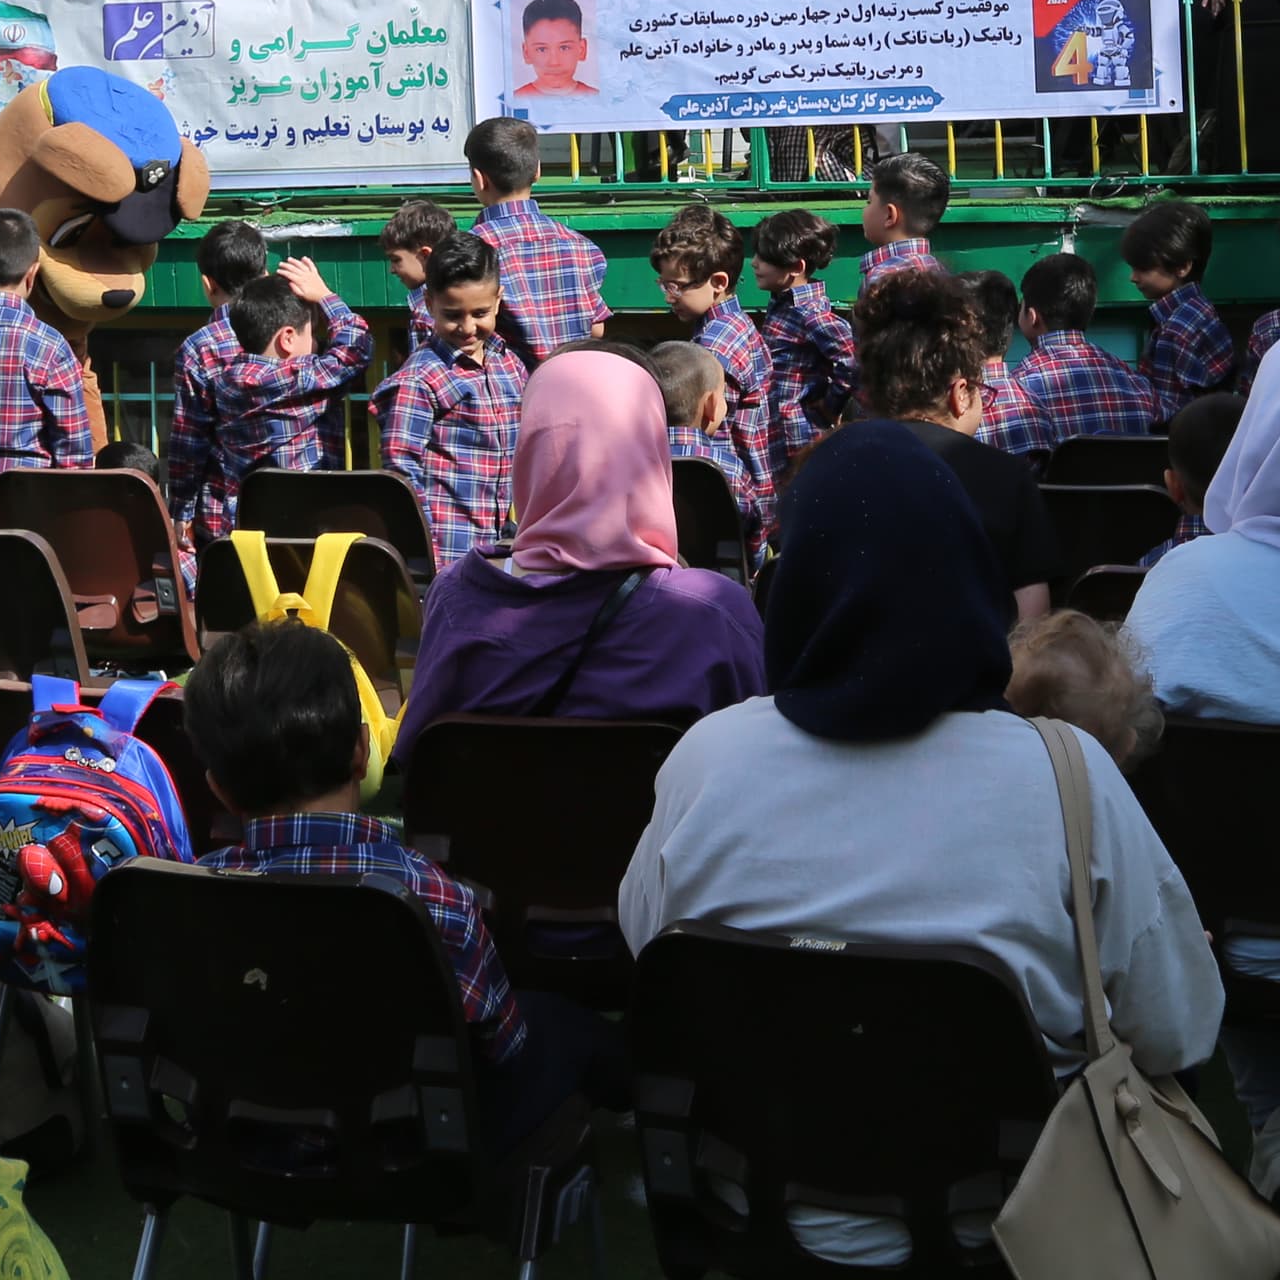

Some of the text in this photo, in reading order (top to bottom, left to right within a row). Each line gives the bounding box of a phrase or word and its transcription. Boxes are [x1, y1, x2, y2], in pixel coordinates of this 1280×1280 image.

[679, 10, 735, 29] مسابقات
[736, 10, 770, 28] دوره
[771, 6, 830, 26] چهارمین
[833, 7, 850, 24] در
[851, 3, 876, 23] اول
[878, 2, 906, 21] رتبه
[907, 0, 945, 20] کسب
[946, 5, 955, 19] و
[629, 12, 678, 32] کشوری
[111, 5, 155, 61] علم
[825, 33, 851, 49] شما
[869, 32, 881, 51] را
[972, 26, 1022, 45] رباتیک
[229, 38, 242, 62] و
[619, 42, 643, 61] علم
[645, 38, 680, 60] آذین
[682, 37, 733, 58] خانواده
[736, 44, 744, 56] و
[746, 37, 776, 57] مادر
[778, 42, 786, 55] و
[790, 37, 813, 55] پدر
[814, 39, 823, 53] و
[852, 37, 866, 52] به
[1051, 31, 1093, 85] 4
[758, 70, 781, 84] می
[782, 63, 826, 83] تبریک
[827, 61, 874, 81] رباتیک
[876, 64, 914, 80] مربی
[226, 61, 449, 104] دانش آموزان عزیز
[678, 98, 699, 118] علم
[699, 96, 730, 117] آذین
[730, 97, 767, 117] دولتی
[767, 96, 787, 115] غیر
[787, 94, 830, 114] دبستان
[829, 92, 878, 113] کارکنان
[885, 93, 934, 111] مدیریت
[225, 118, 278, 147] تربیت
[285, 125, 297, 146] و
[303, 114, 351, 145] تعلیم
[357, 113, 425, 144] بوستان
[431, 115, 451, 140] به
